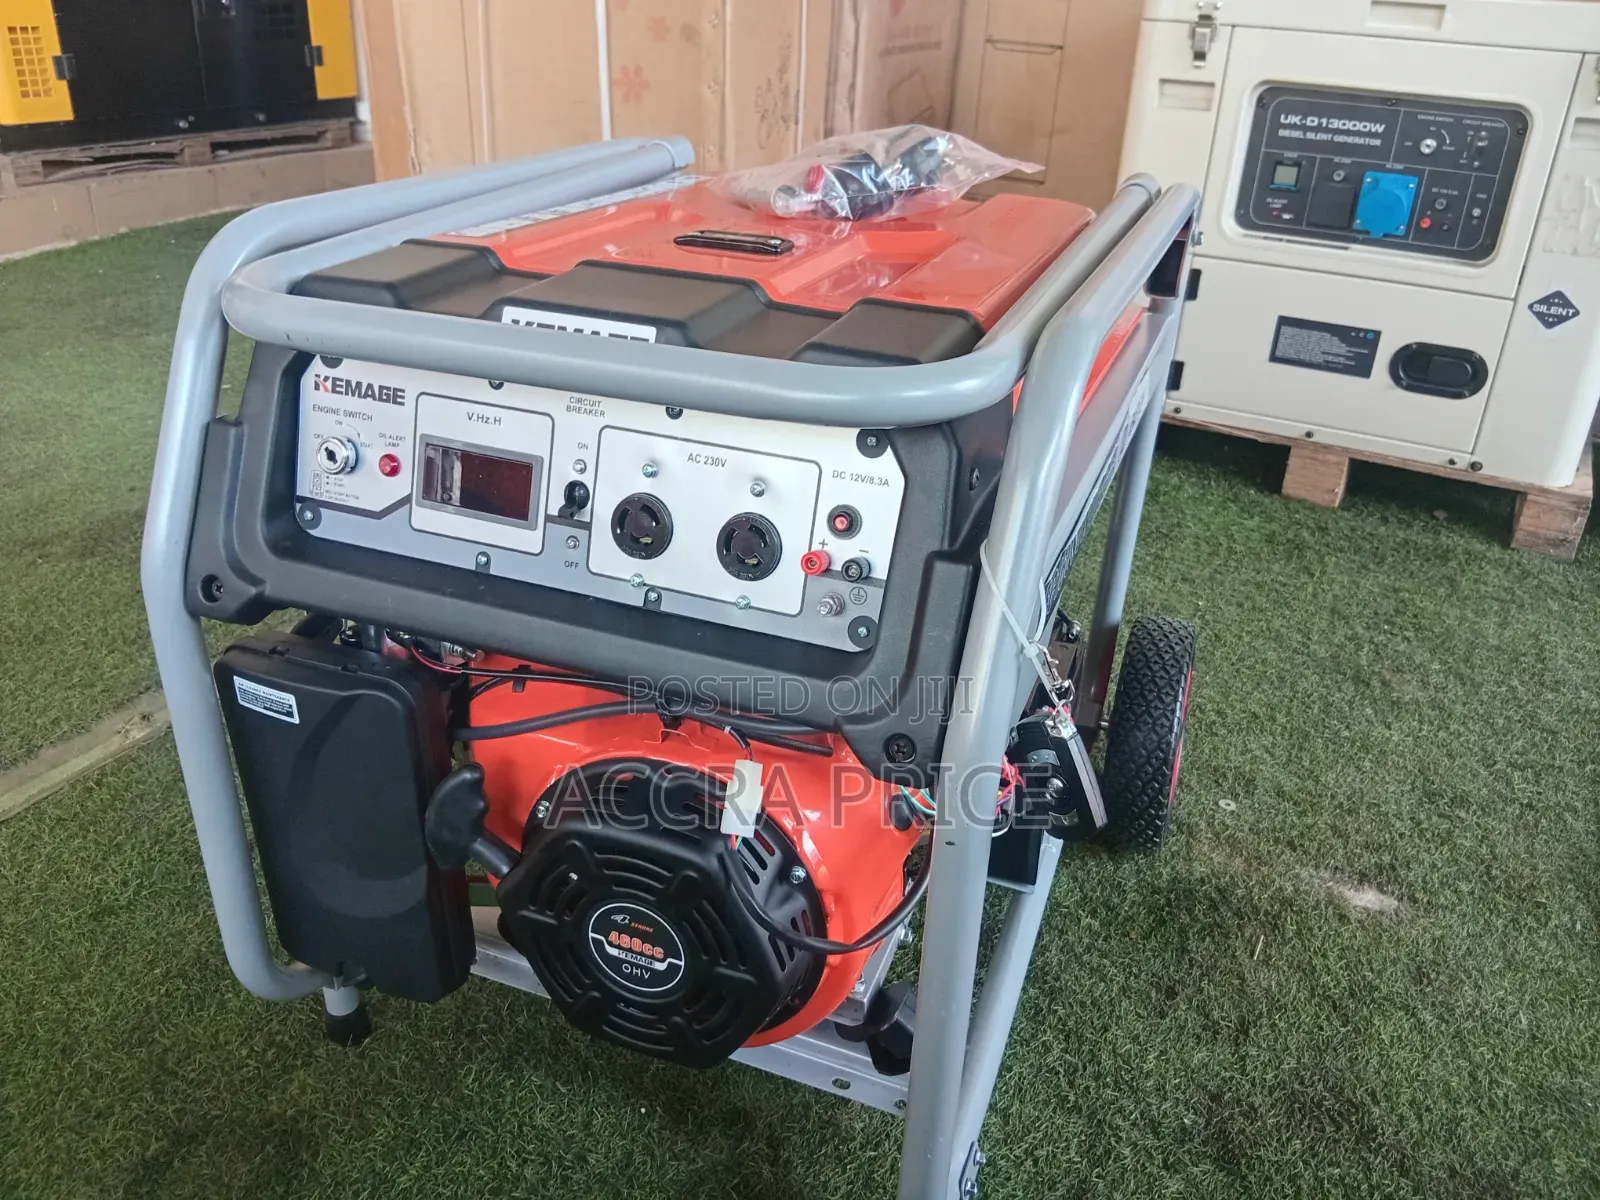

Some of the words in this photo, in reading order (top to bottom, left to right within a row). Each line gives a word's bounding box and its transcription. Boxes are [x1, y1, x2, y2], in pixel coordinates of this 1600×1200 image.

[1280, 114, 1386, 133] UK-D13000W
[1278, 128, 1305, 139] DIESEL
[1306, 131, 1332, 141] SILENT
[1333, 134, 1381, 146] GENERATOR
[1532, 304, 1576, 316] SILENT
[314, 373, 406, 406] KEMAGE
[569, 396, 602, 408] CIRCUIT
[312, 404, 341, 416] ENGINE
[343, 409, 373, 422] SWITCH
[566, 404, 605, 418] BREAKER
[467, 412, 501, 426] V.Hz.H
[578, 442, 588, 450] ON
[687, 453, 701, 464] AC
[704, 456, 727, 468] 230V
[832, 470, 846, 479] DC
[850, 473, 889, 487] 12V/8.3A
[564, 561, 579, 569] OFF
[618, 950, 655, 967] KEMAGE
[622, 963, 650, 979] OHV
